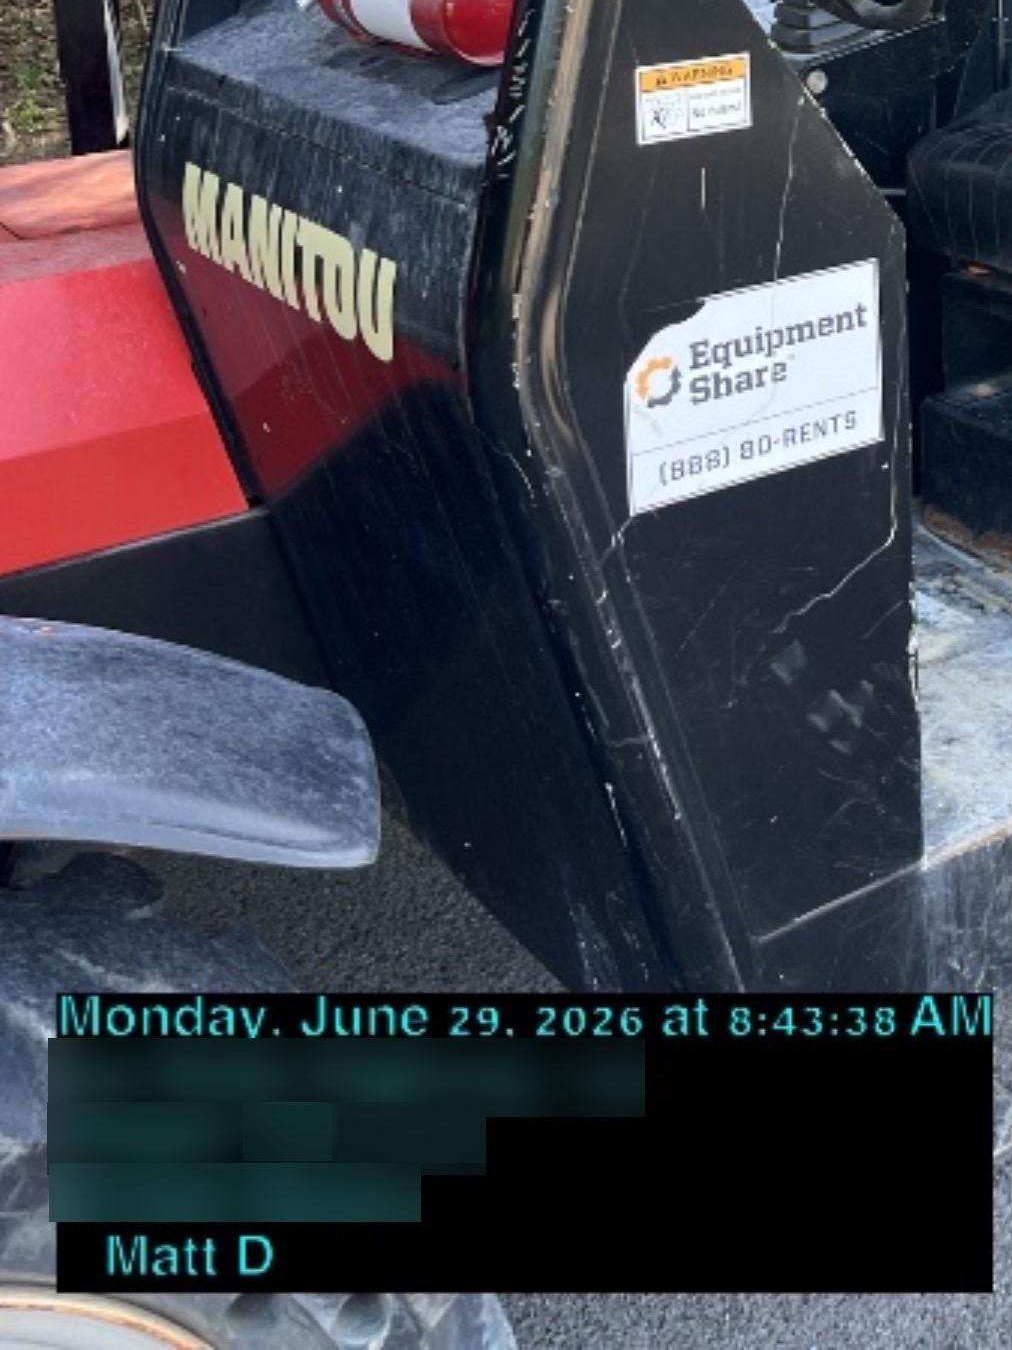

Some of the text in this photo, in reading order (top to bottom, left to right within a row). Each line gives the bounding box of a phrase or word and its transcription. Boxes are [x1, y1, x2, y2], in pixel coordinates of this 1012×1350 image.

[181, 161, 397, 364] MANITOU
[688, 302, 868, 369] Equipment
[689, 360, 787, 406] Share
[659, 410, 858, 486] (888) 80-RENTS
